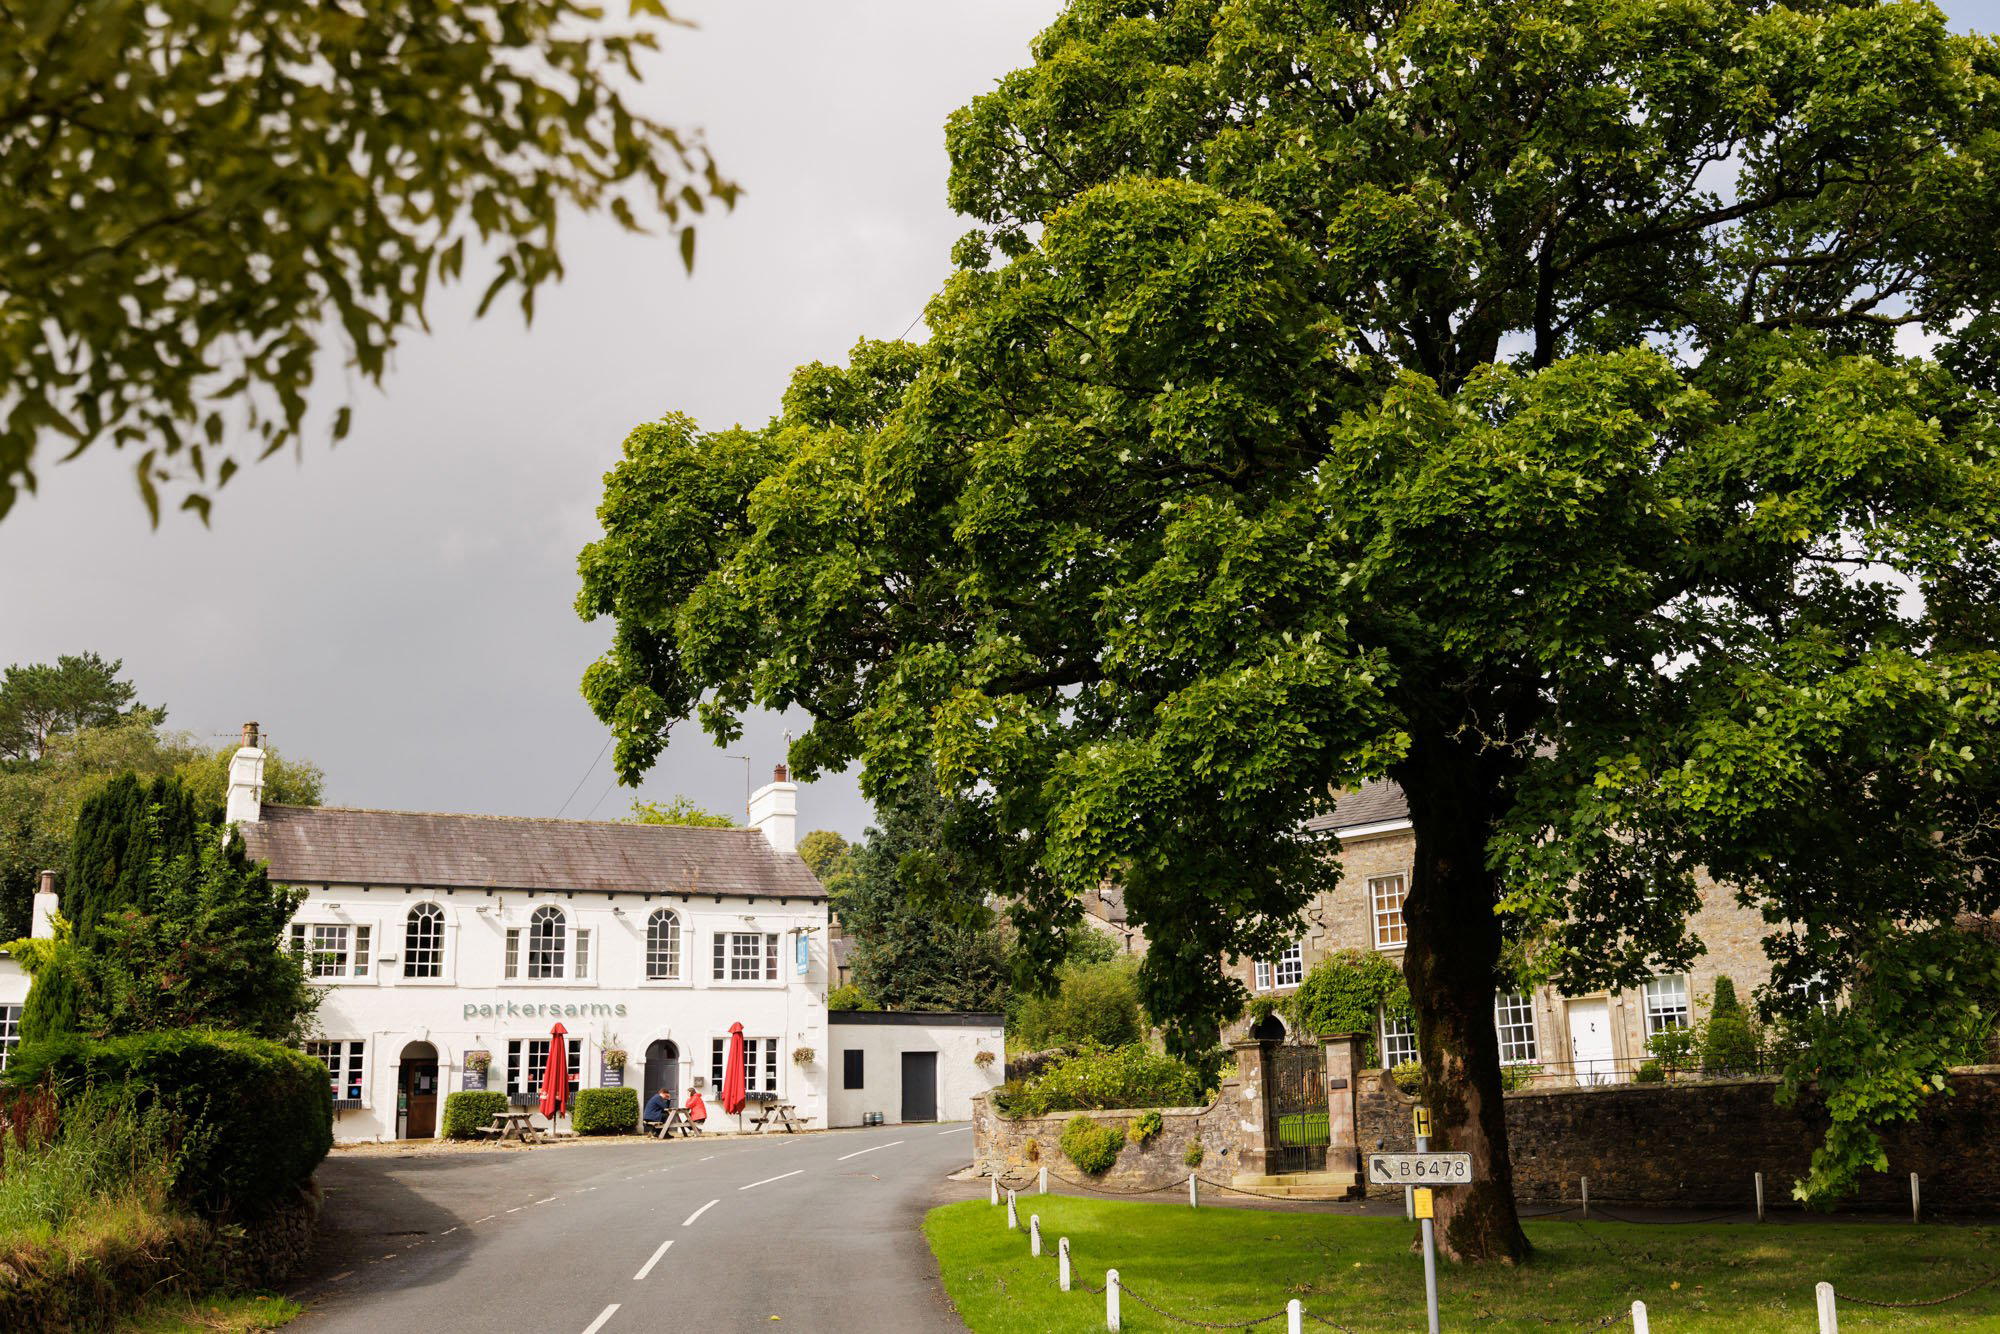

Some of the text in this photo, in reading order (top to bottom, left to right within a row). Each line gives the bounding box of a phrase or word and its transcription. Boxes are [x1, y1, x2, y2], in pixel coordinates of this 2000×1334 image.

[463, 1000, 628, 1021] parkersarms
[1416, 1111, 1431, 1134] H
[1400, 1161, 1465, 1177] B6478
